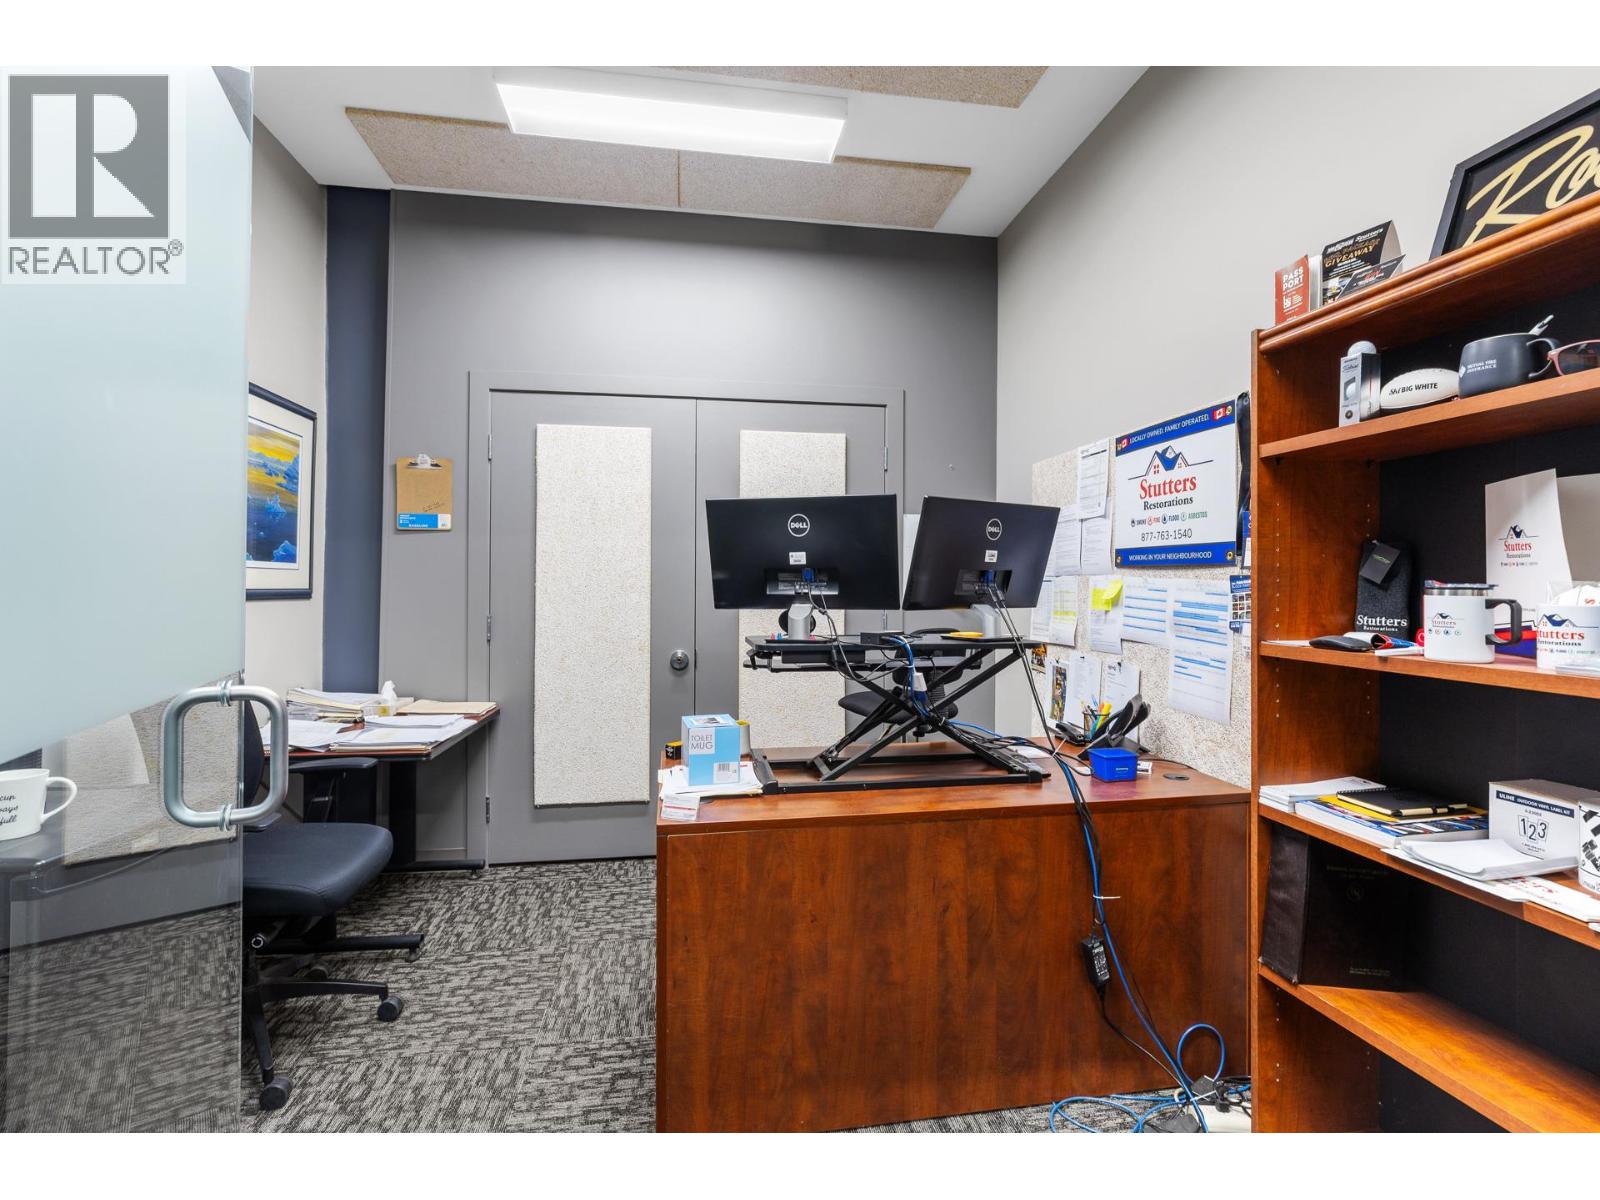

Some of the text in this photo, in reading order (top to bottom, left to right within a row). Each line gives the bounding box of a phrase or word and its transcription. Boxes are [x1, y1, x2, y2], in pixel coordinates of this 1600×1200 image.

[1325, 245, 1375, 268] GIVEAWAY
[1283, 266, 1304, 283] PASS
[1283, 275, 1304, 291] PORT
[1401, 385, 1414, 393] BIG
[1415, 382, 1439, 391] WHITE
[1130, 433, 1147, 444] LOCALLY
[1164, 423, 1181, 433] FAMILY
[1139, 476, 1197, 500] Stutters
[1143, 496, 1194, 511] Restorations
[790, 521, 808, 529] DELL
[1140, 528, 1193, 542] 877-763-1540
[1503, 540, 1532, 552] Stutters
[1152, 553, 1167, 561] YOUR
[1166, 551, 1212, 560] NEIGHBOURHOOD
[1356, 614, 1408, 627] Stutters
[1537, 630, 1585, 640] tutters
[691, 734, 713, 742] TOILET
[691, 742, 713, 750] MUG
